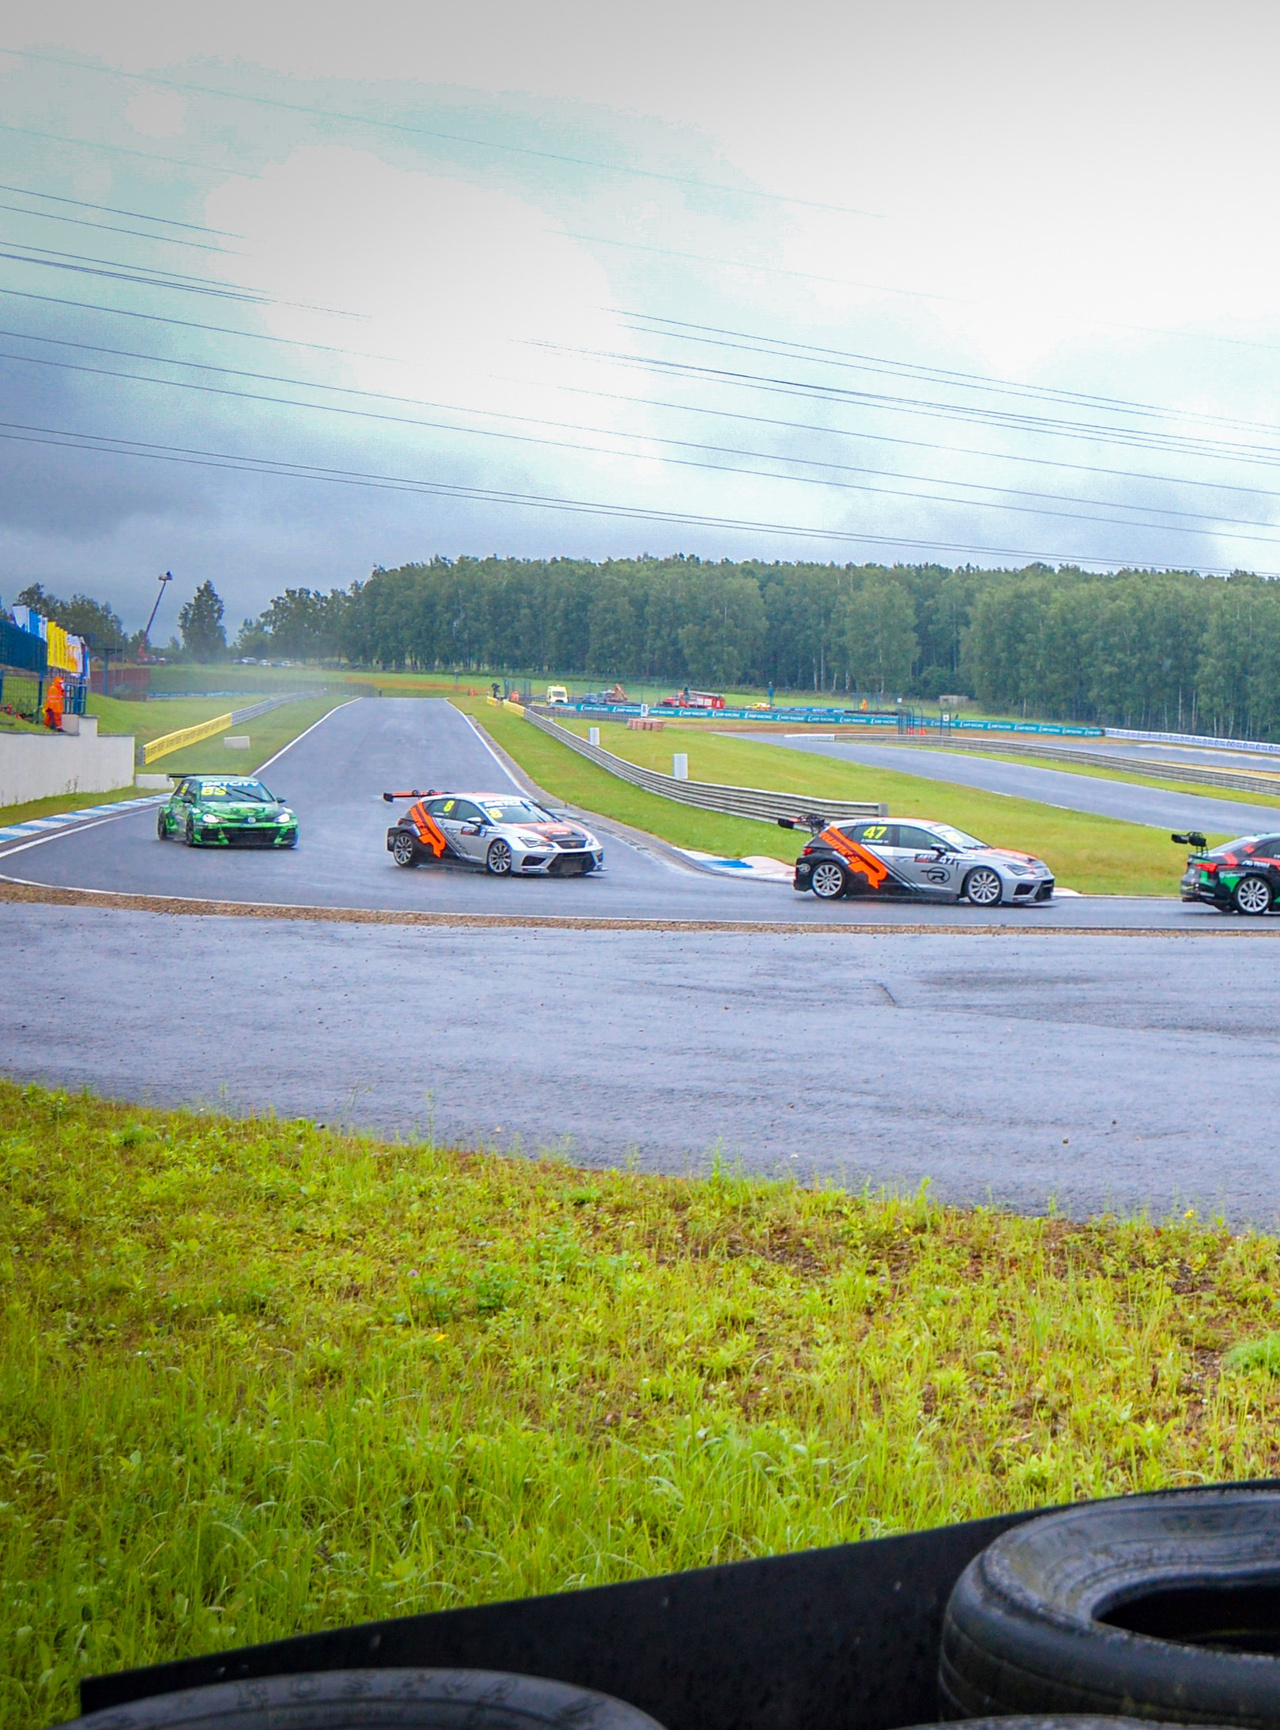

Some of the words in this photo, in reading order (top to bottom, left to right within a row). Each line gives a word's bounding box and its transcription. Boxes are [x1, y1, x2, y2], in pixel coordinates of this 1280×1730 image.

[443, 800, 454, 812] 8
[863, 826, 888, 839] 47
[938, 855, 954, 865] 47
